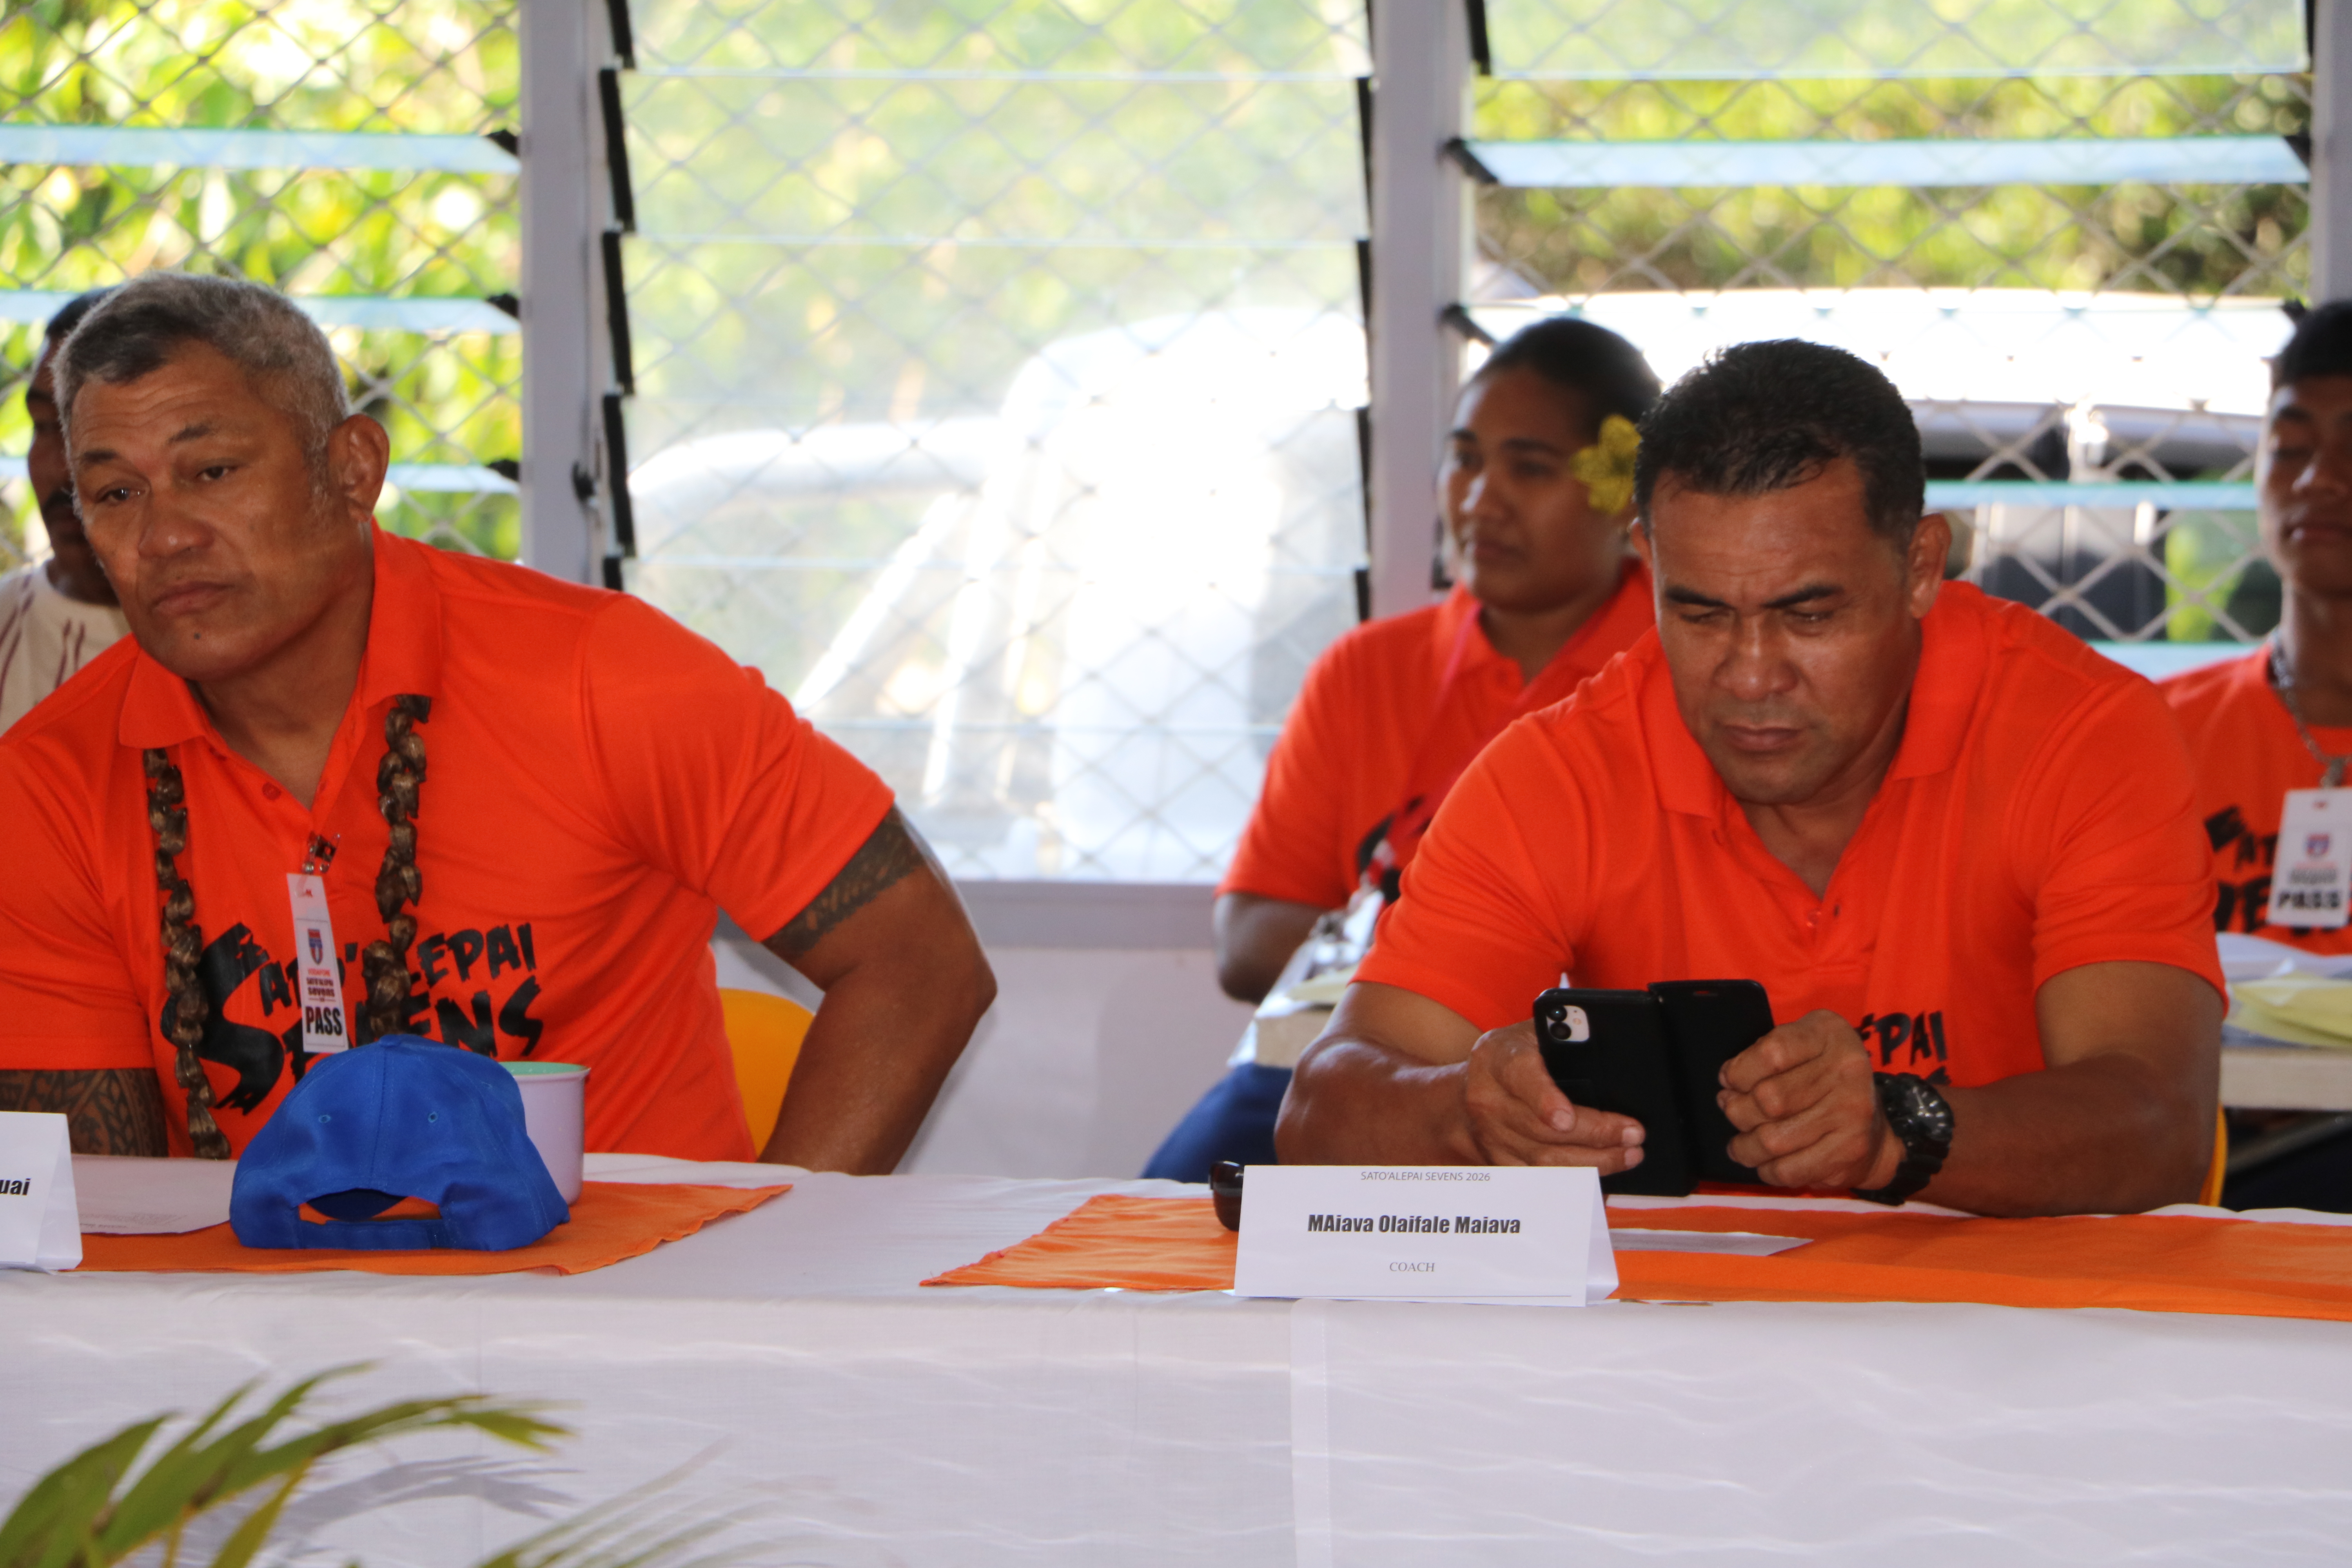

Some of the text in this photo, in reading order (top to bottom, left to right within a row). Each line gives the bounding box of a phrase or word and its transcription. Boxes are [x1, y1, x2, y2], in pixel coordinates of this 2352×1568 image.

[306, 1007, 342, 1035] PASS
[1425, 1172, 1463, 1181] SEVENS
[1466, 1173, 1490, 1181] 2026
[1308, 1214, 1520, 1234] MAiava Olaifale Maiava
[1390, 1262, 1435, 1272] COACH
